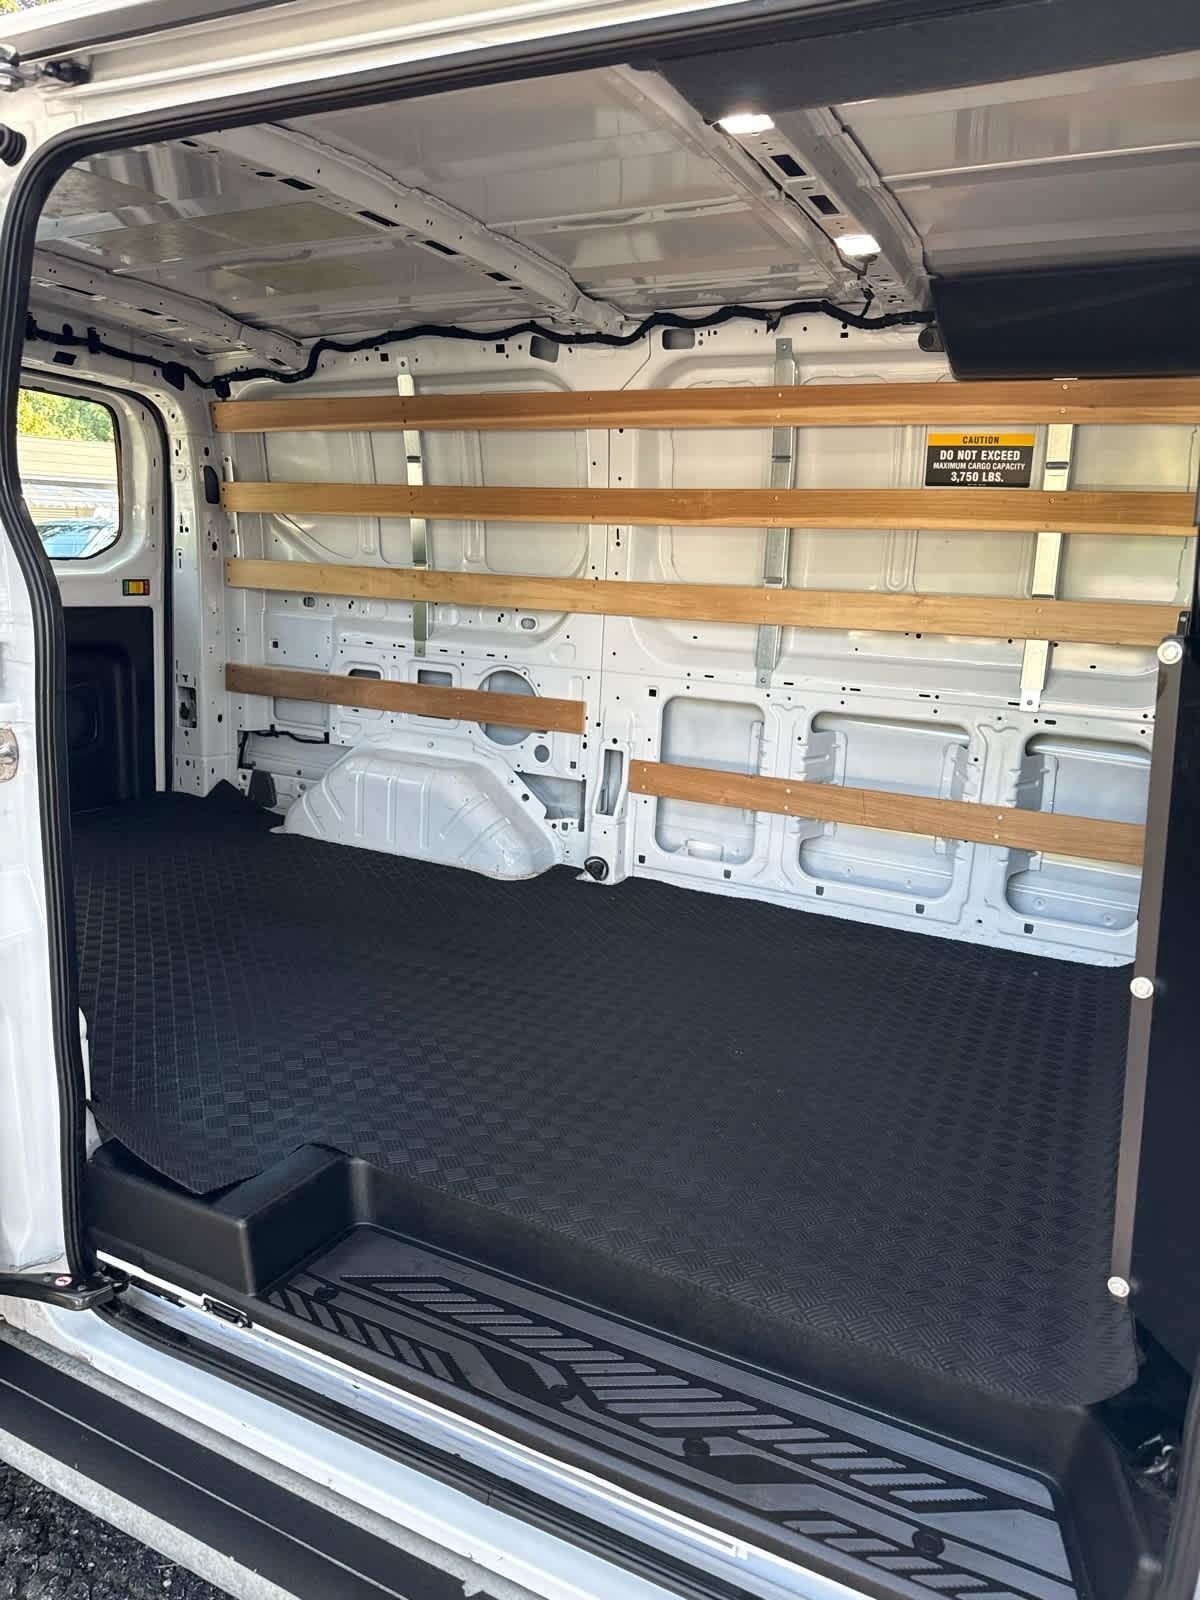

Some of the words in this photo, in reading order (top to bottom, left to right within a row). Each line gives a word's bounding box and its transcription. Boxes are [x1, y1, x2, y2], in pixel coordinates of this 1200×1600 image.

[962, 436, 999, 444] CAUTION
[940, 450, 953, 460] DO
[957, 450, 977, 460] NOT
[981, 451, 1020, 460] EXCEED
[951, 472, 978, 483] 3,750
[982, 472, 1004, 482] LBS.
